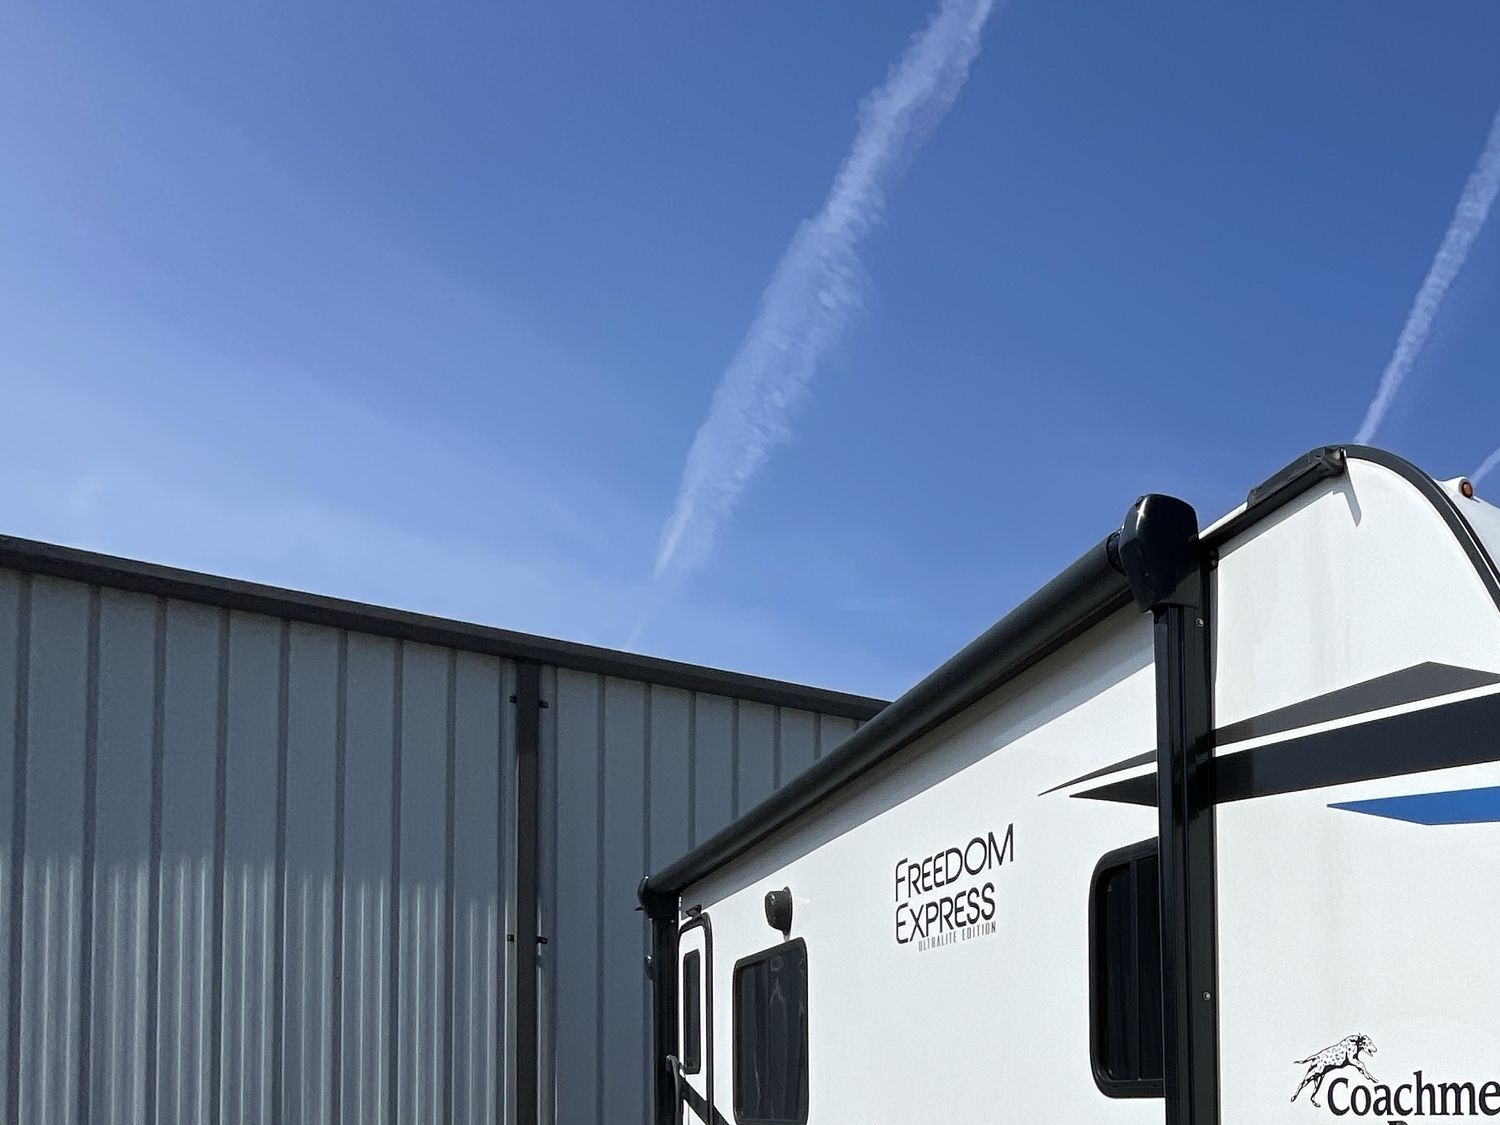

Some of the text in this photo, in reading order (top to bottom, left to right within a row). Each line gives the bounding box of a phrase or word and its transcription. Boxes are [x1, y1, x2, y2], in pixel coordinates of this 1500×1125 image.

[894, 822, 1014, 902] FREEDOM
[895, 881, 996, 944] EXPRESS
[918, 920, 997, 952] ULTRALITE EDITION
